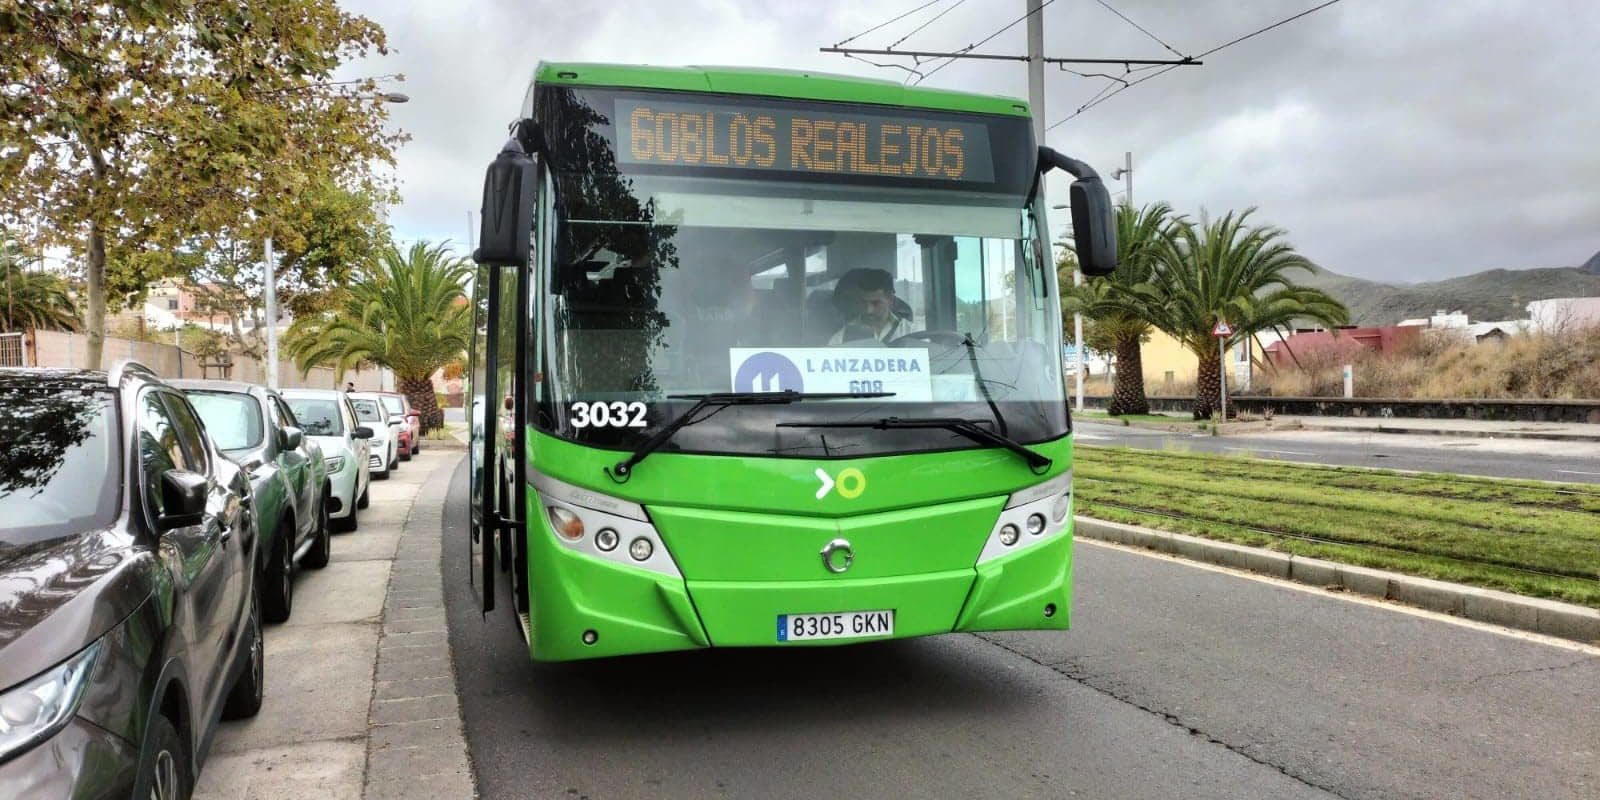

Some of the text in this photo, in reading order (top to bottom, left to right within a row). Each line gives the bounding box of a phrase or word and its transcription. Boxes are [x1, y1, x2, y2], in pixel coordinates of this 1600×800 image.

[791, 118, 965, 180] REALEJOS
[570, 400, 648, 428] 3032
[793, 612, 889, 636] 8305 GKN
